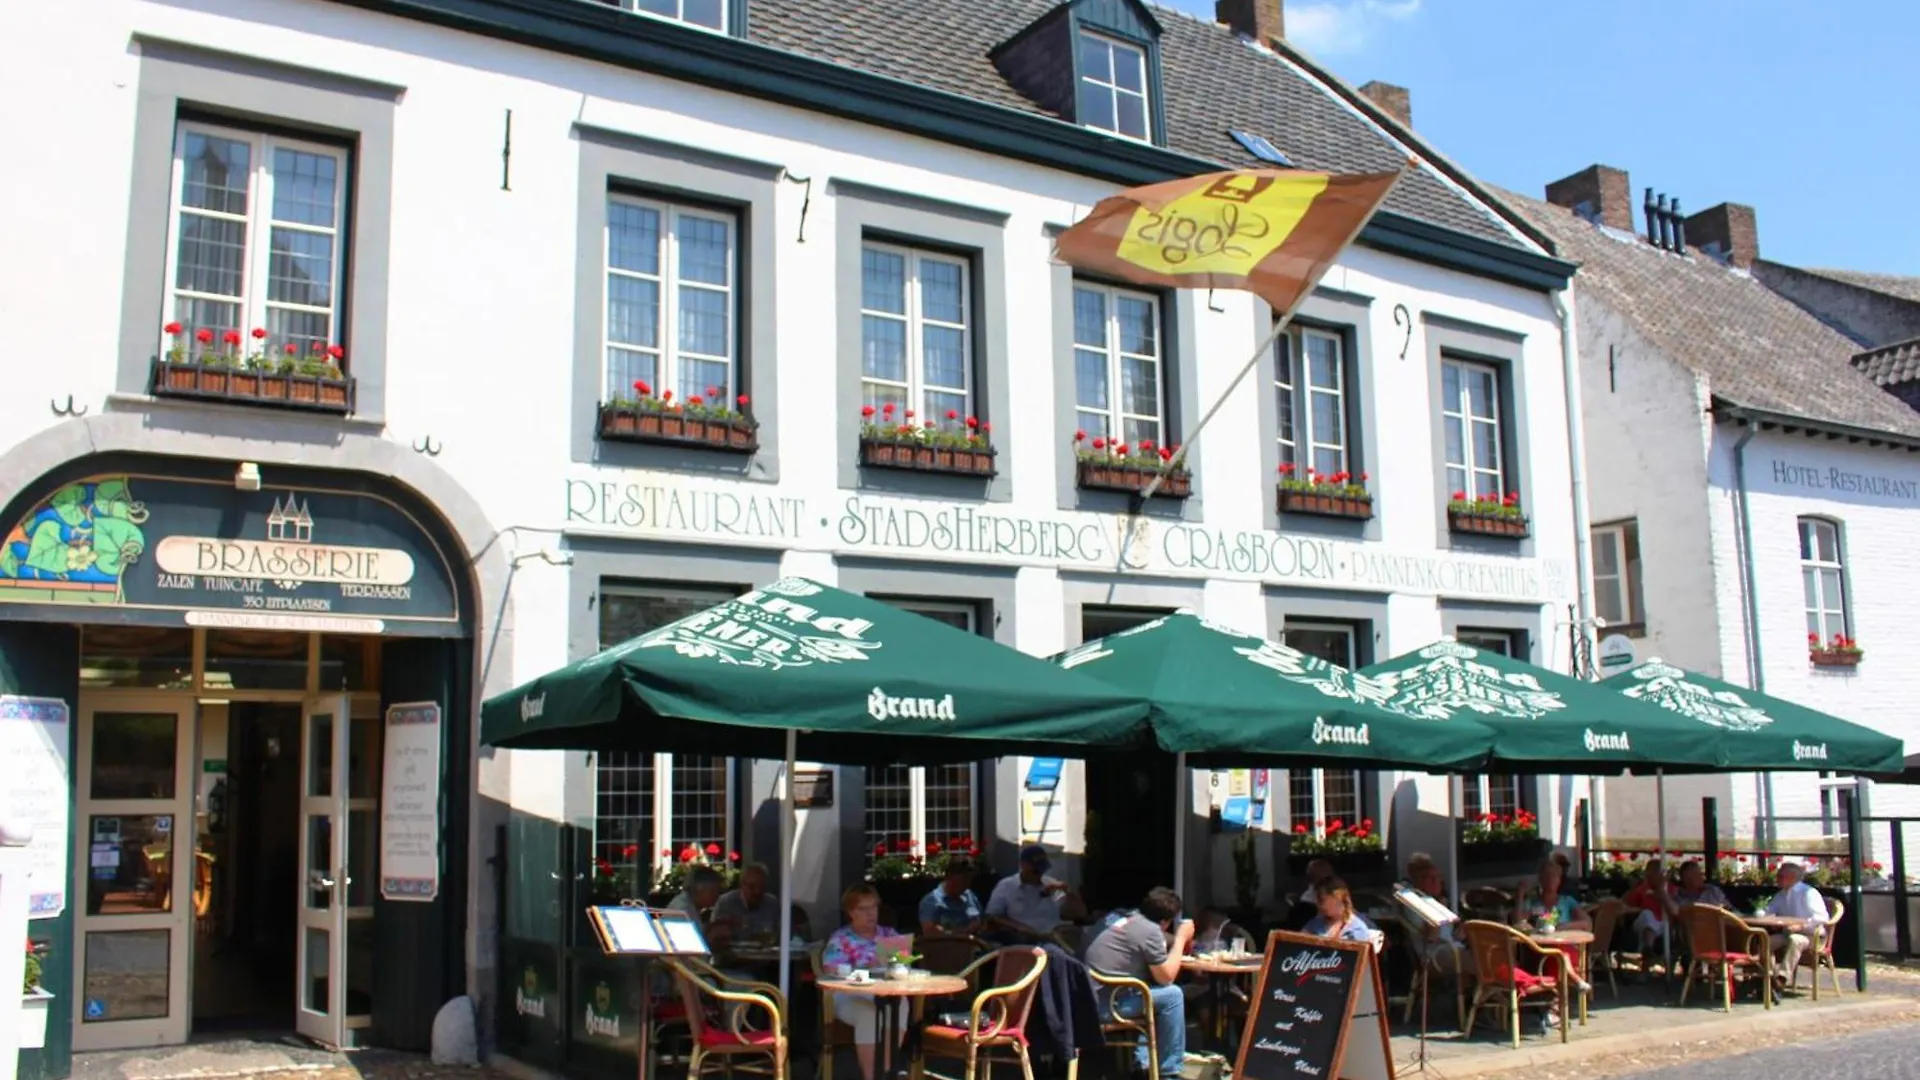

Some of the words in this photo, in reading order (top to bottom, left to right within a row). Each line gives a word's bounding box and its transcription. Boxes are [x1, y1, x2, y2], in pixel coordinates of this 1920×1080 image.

[1772, 459, 1918, 499] HOTEL-RESTAURANT
[565, 479, 806, 538] RESTAURANT
[838, 496, 1103, 561] STADSHERBERG
[1163, 525, 1335, 582] CRASBORN
[196, 541, 380, 580] BRASSERIE
[157, 574, 196, 588] ZALEN
[867, 686, 956, 721] Brand
[1311, 715, 1369, 745] Brand
[1584, 728, 1630, 751] Brand
[1792, 739, 1828, 760] Brand
[1211, 773, 1219, 787] 6
[1281, 950, 1342, 976] Alfredo
